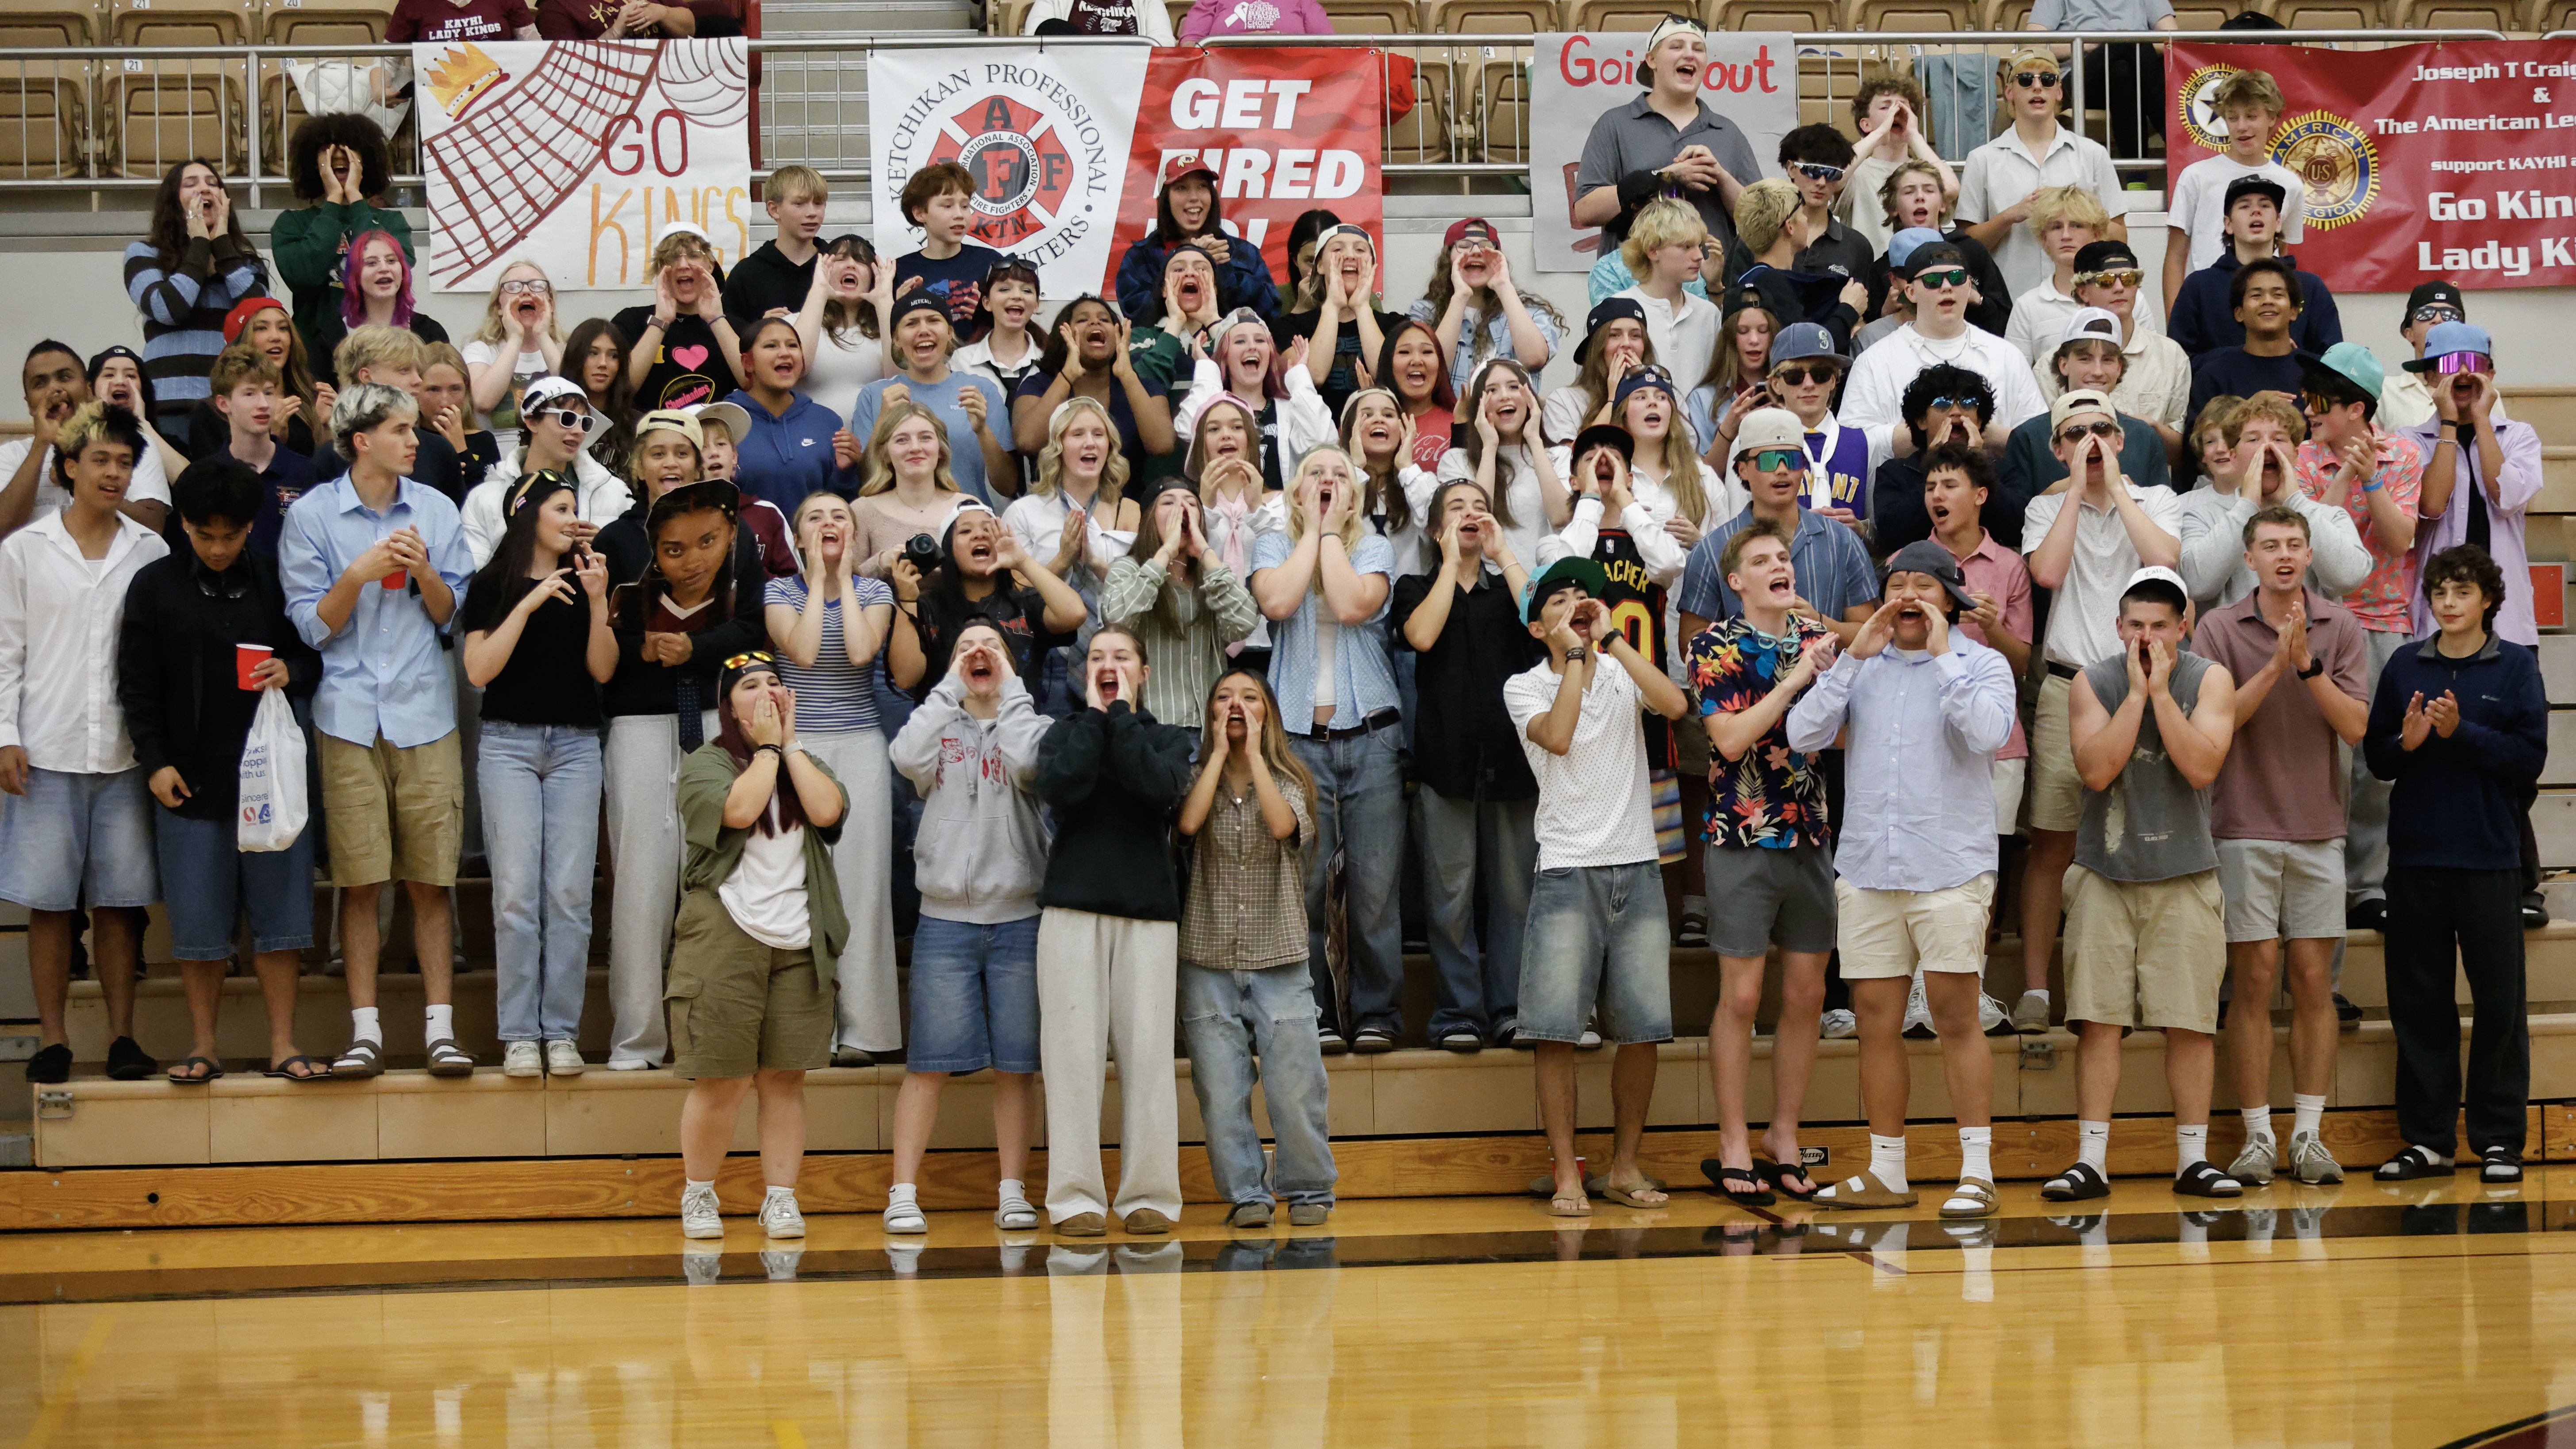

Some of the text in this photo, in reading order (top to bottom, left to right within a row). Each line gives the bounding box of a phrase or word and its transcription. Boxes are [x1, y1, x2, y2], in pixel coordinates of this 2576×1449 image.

[429, 23, 502, 40] LADY KINGS
[445, 15, 483, 29] KAYHI
[129, 60, 139, 70] 21
[1560, 35, 1778, 93] Goi out
[2412, 62, 2499, 83] Joseph
[2504, 61, 2519, 78] T
[1170, 77, 1312, 130] GET
[2533, 87, 2552, 103] &
[888, 69, 972, 203] KETCHIKAN
[984, 64, 1107, 197] PROFESSIONAL
[2374, 112, 2576, 135] The American Le
[601, 109, 688, 177] GO
[2277, 122, 2365, 158] AMERICAN
[1008, 134, 1038, 186] ASSOCIATION
[2430, 159, 2506, 173] support
[2508, 155, 2566, 170] KAYHI
[990, 192, 1028, 214] FIGHTERS
[2303, 199, 2357, 217] EGION
[2428, 190, 2576, 221] Go Kin
[971, 213, 1027, 239] KTN
[2418, 240, 2531, 277] Lady
